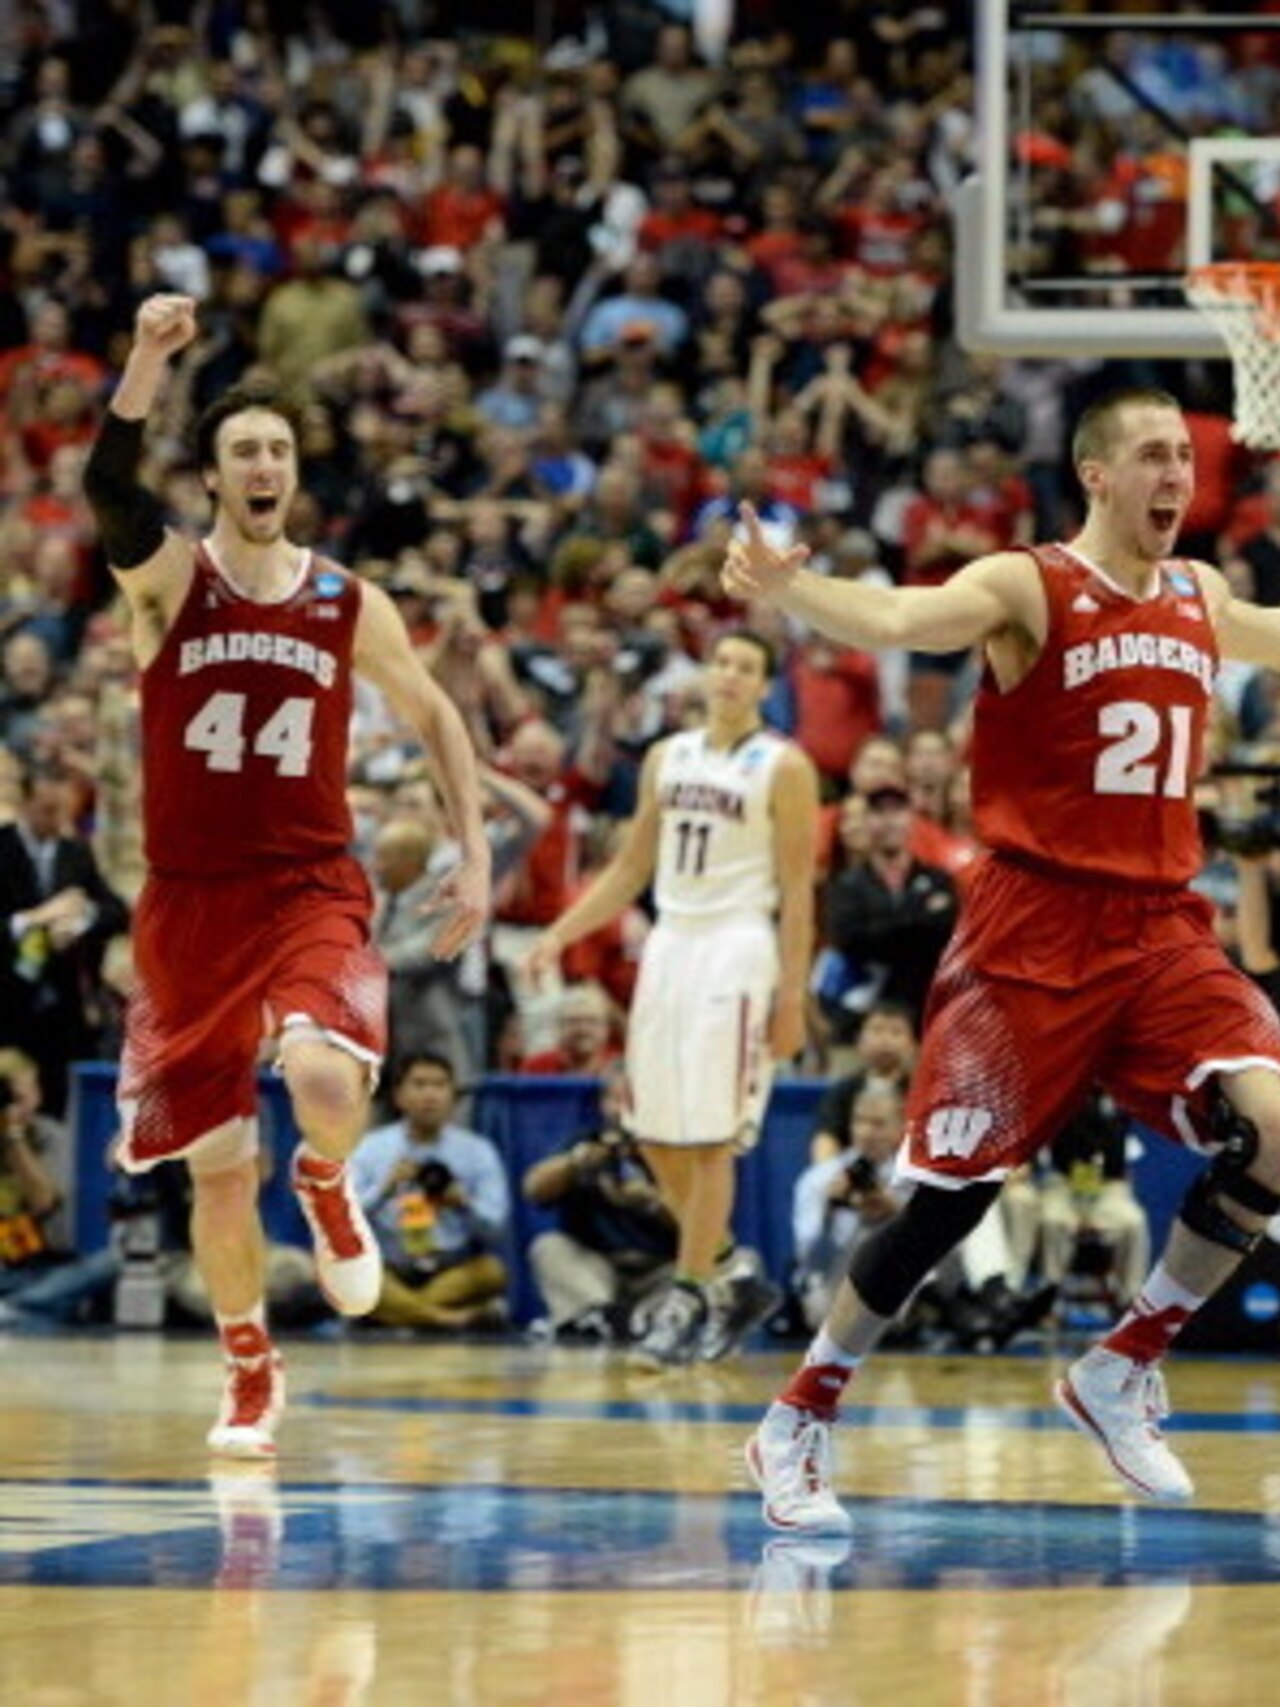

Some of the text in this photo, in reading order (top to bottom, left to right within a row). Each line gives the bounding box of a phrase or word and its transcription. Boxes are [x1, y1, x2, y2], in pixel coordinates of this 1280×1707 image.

[178, 631, 338, 690] BADGERS
[184, 691, 315, 777] 44
[1093, 700, 1194, 798] 21
[677, 820, 710, 876] 11
[926, 1106, 992, 1160] W
